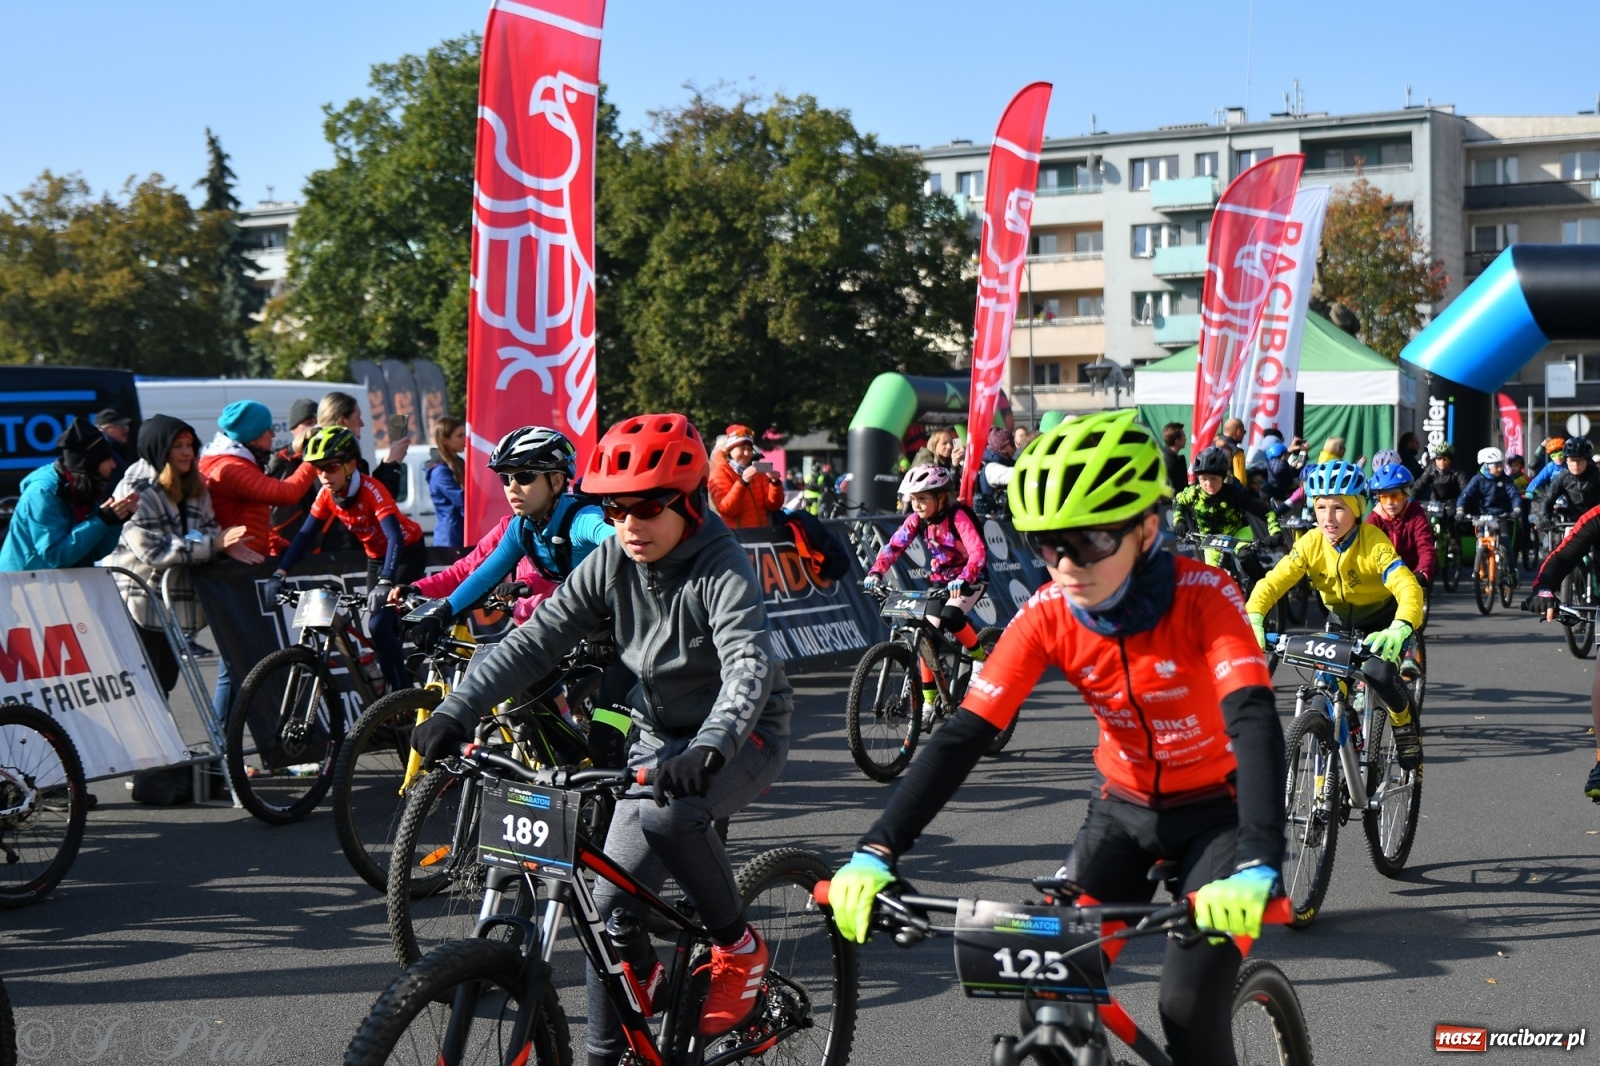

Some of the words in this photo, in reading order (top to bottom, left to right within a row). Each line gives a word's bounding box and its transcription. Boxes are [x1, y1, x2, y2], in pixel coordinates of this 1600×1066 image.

[788, 620, 867, 657] NAJLEPSZYCH
[1304, 640, 1336, 659] 166
[40, 670, 136, 715] FRIENDS
[1152, 714, 1199, 731] BIKE
[502, 814, 549, 848] 189
[993, 947, 1069, 981] 125
